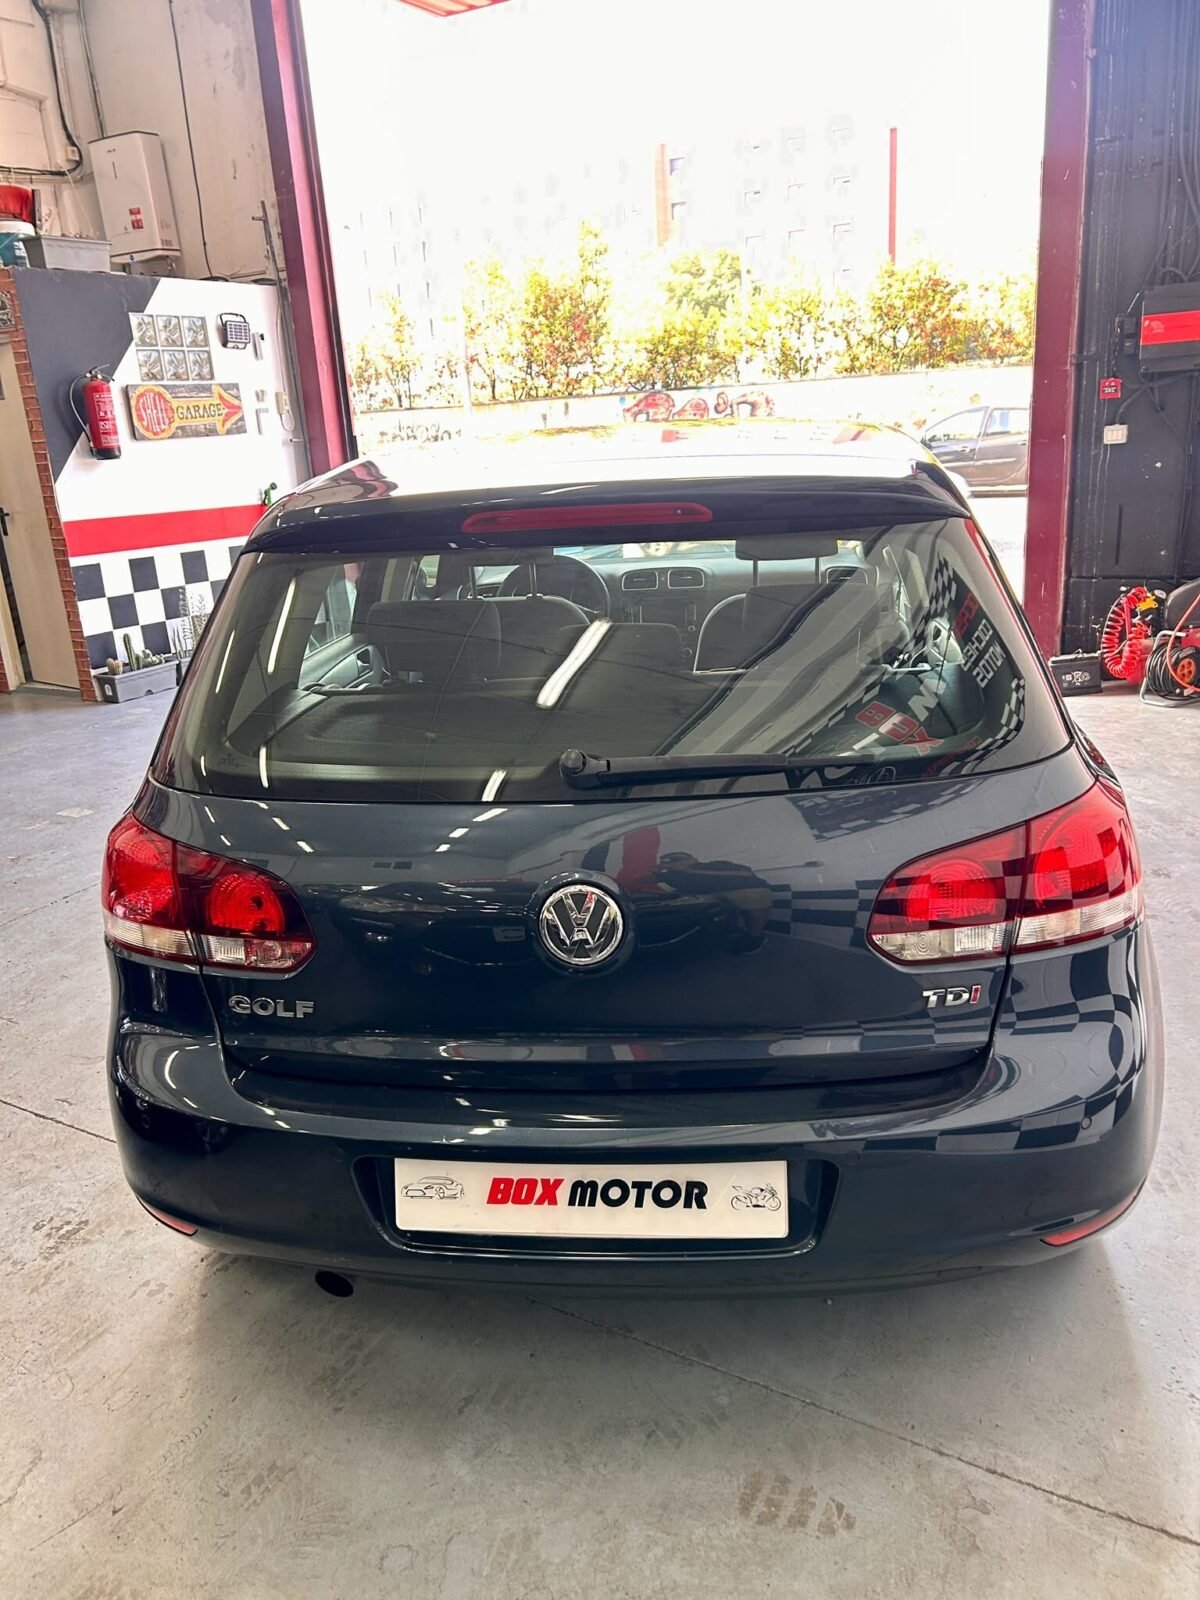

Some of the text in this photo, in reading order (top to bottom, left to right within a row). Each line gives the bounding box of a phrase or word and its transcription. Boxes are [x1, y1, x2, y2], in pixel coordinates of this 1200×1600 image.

[175, 403, 223, 420] GARAGE
[228, 995, 315, 1018] GOLF
[922, 985, 982, 1008] TDI
[486, 1177, 709, 1210] BOX MOTOR
